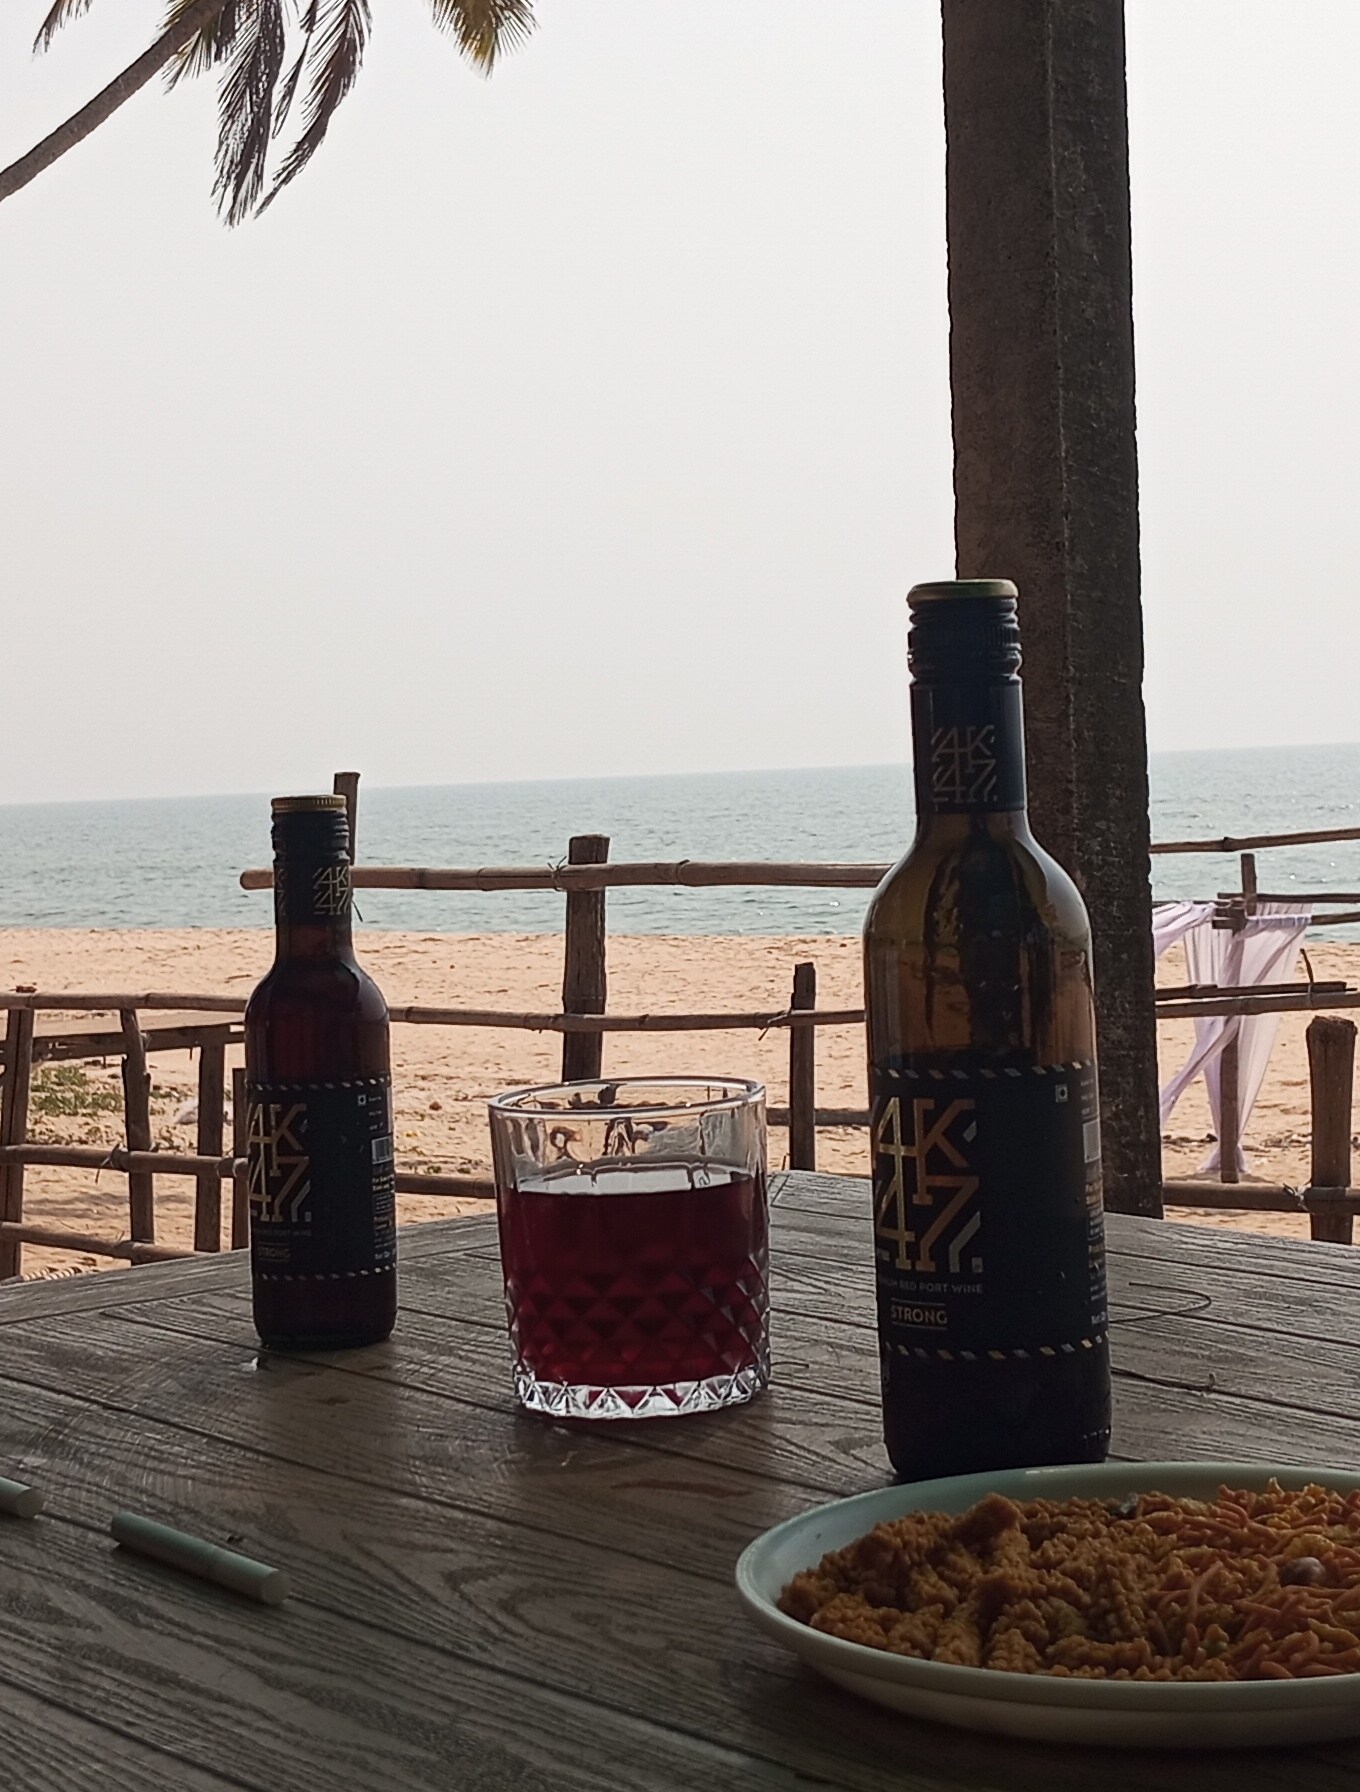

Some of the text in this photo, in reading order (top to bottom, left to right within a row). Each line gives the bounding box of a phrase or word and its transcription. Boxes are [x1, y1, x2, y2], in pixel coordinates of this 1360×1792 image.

[918, 1281, 949, 1294] PORT
[950, 1282, 984, 1295] WINE
[890, 1303, 948, 1325] STRONG
